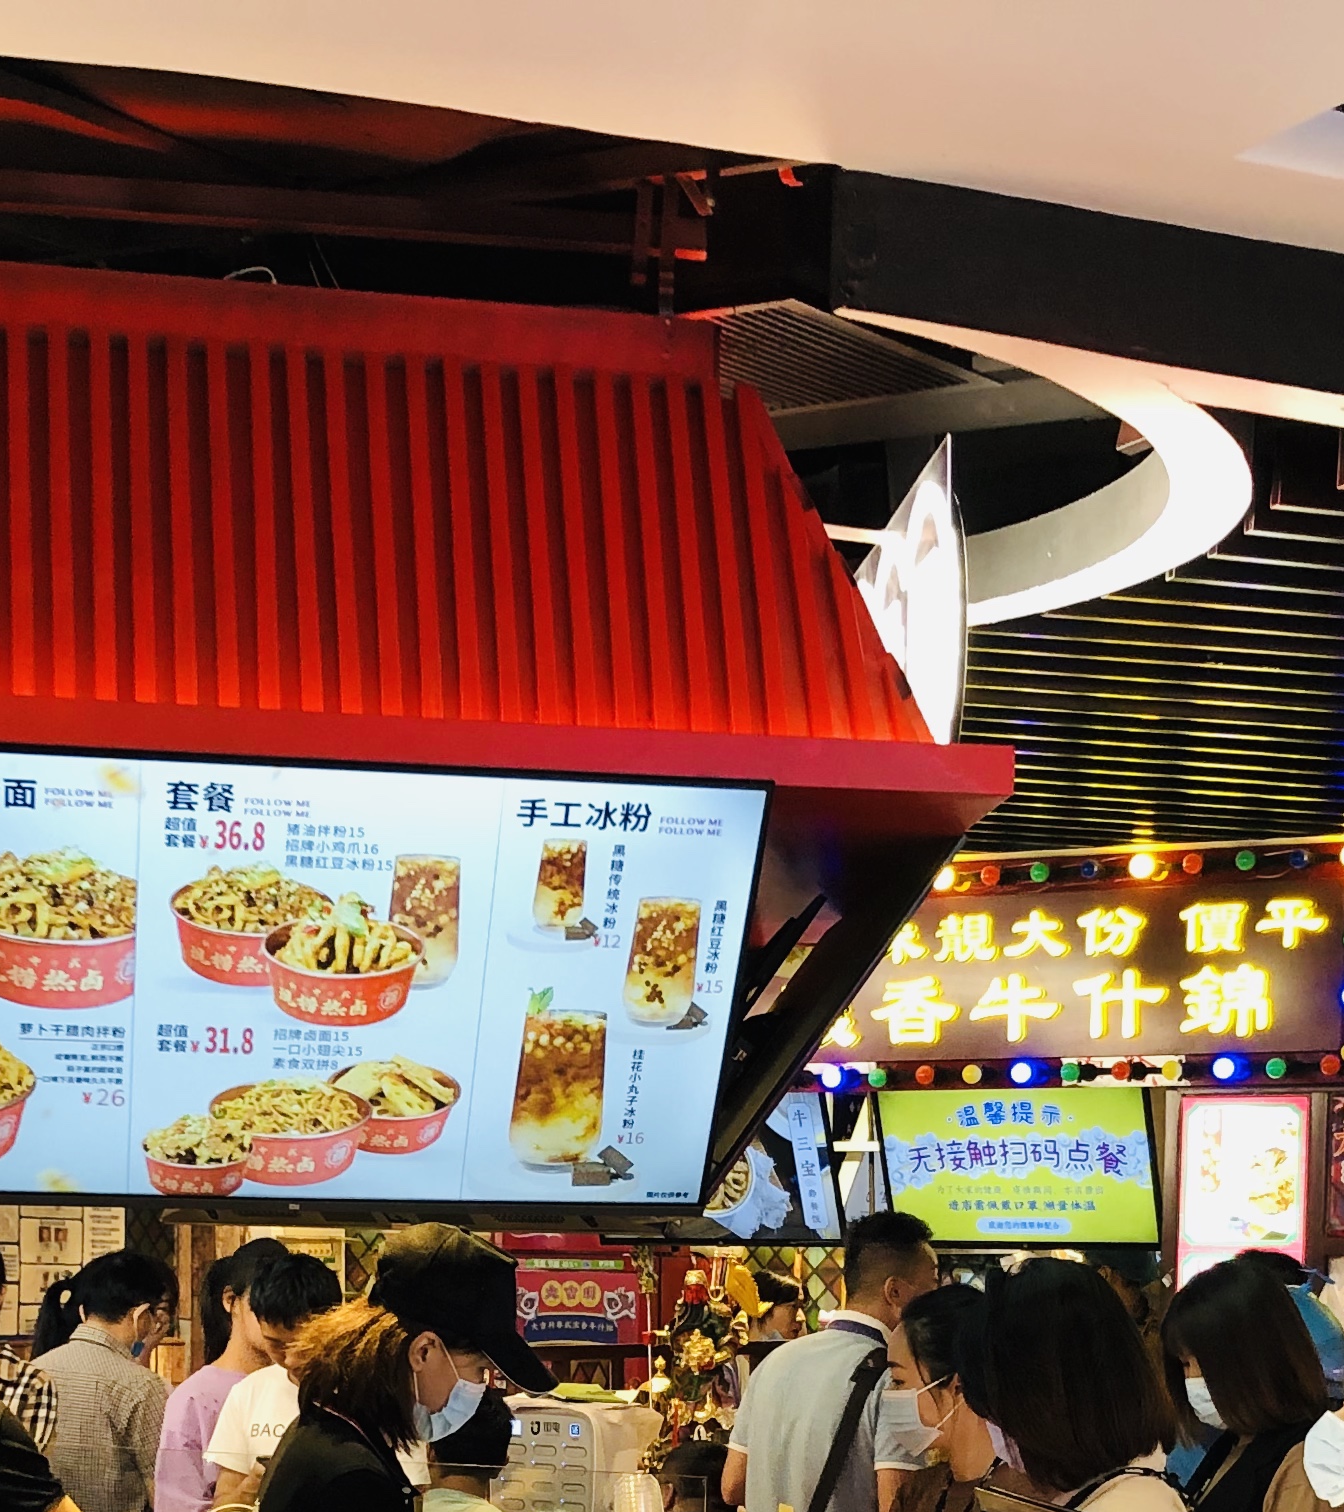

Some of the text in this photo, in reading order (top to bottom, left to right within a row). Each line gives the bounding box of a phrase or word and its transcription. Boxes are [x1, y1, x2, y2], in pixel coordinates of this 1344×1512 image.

[45, 787, 94, 798] FOLLOW
[166, 780, 235, 813] 套餐
[44, 798, 94, 808] FOLLOW
[244, 797, 292, 807] FOLLOW
[244, 808, 292, 817] FOLLOW
[516, 798, 652, 832] 手工冰粉
[165, 816, 197, 832] 超值
[660, 816, 724, 827] FOLLOW ME
[658, 827, 722, 837] FOLLOW ME
[165, 833, 197, 849] 套餐
[602, 844, 626, 929] 黑糖传统冰粉
[1179, 899, 1328, 955] 價平
[704, 900, 727, 974] 黑糖红豆冰粉
[157, 1023, 189, 1038] 超值
[158, 1039, 187, 1052] 套餐
[272, 1057, 338, 1071] 素食双拼8
[622, 1049, 645, 1130] 桂花小丸子冰粉
[957, 1101, 1061, 1127] 温馨提示
[791, 1109, 817, 1178] 牛三宝
[909, 1138, 1128, 1177] 无接触扫码点餐
